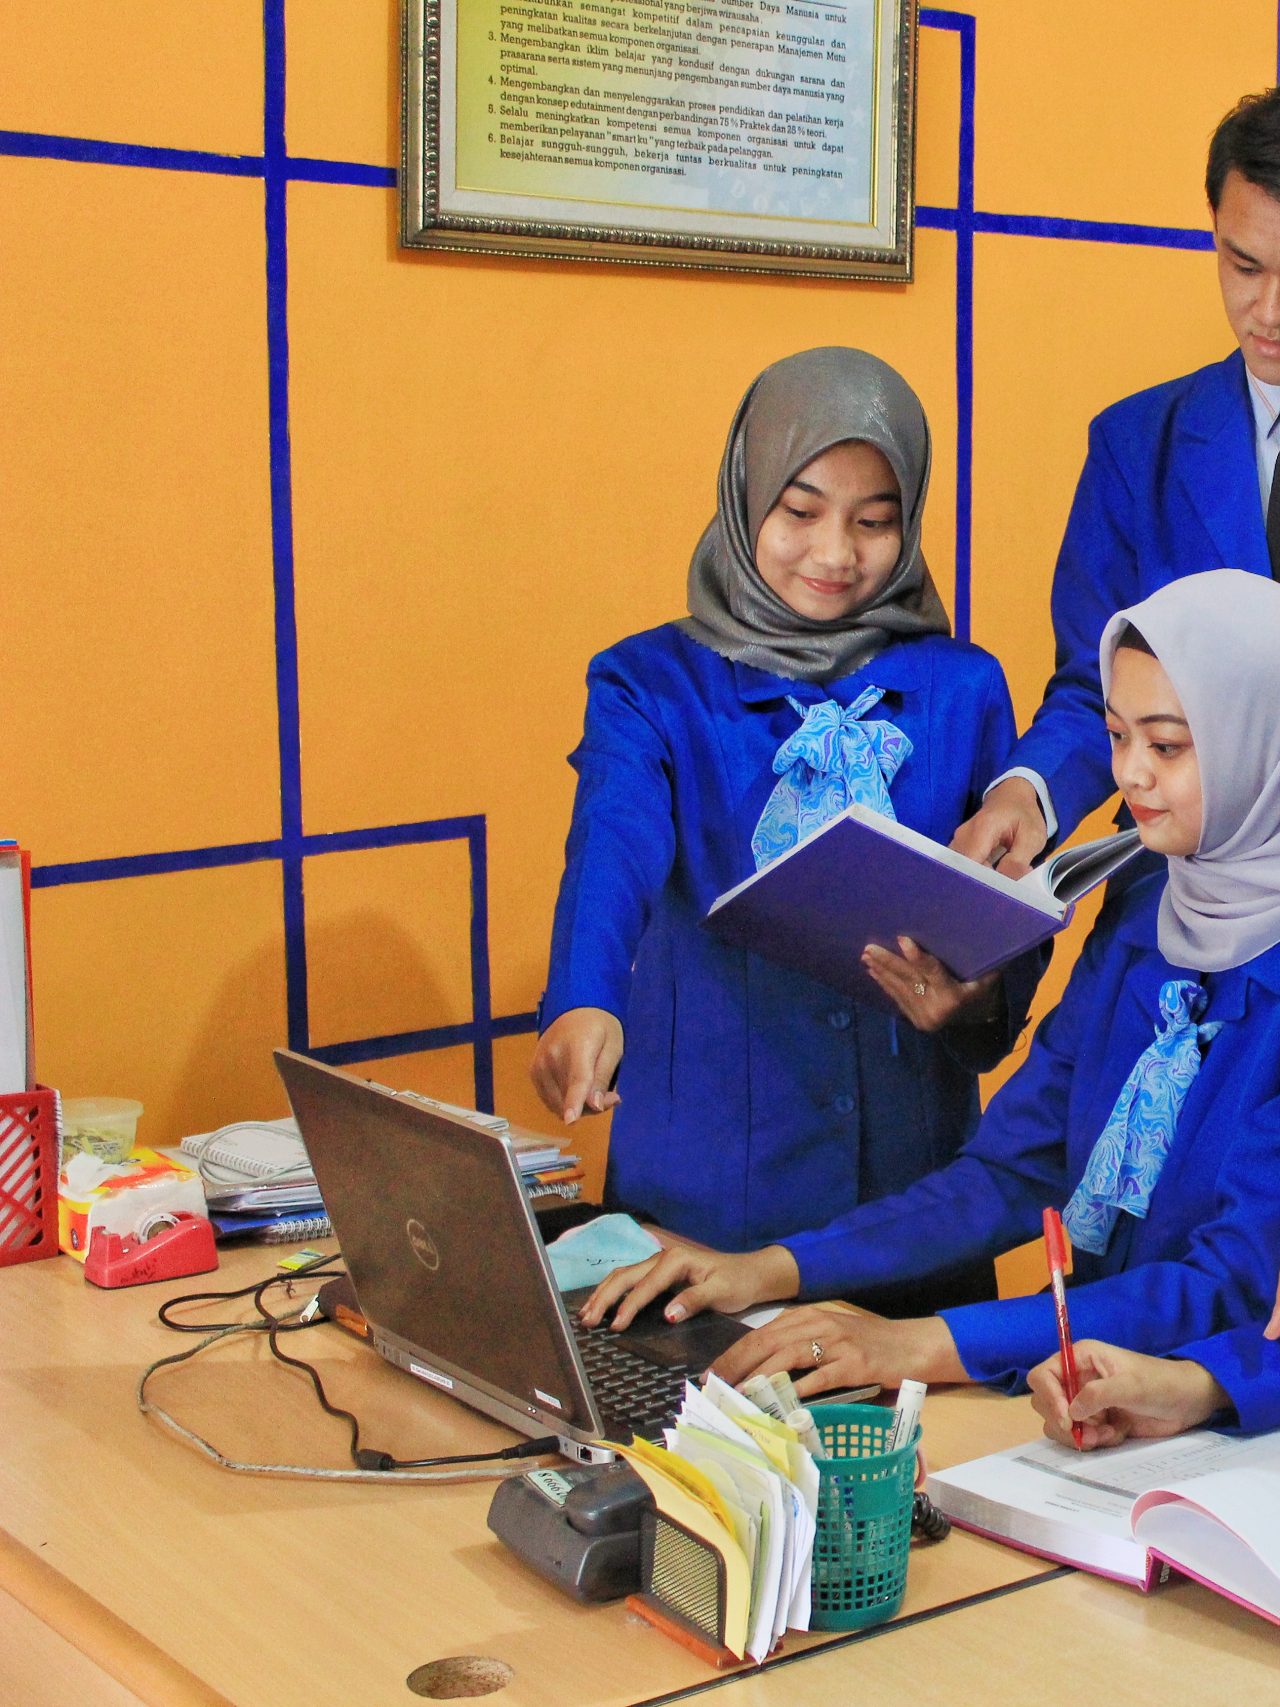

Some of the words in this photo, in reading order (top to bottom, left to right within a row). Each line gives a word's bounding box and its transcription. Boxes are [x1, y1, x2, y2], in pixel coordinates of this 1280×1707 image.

[500, 5, 558, 21] peningkatan
[562, 11, 597, 26] kualitas
[600, 19, 629, 31] secara
[633, 22, 692, 40] berkelanjutan
[695, 32, 727, 46] dengan
[730, 39, 774, 53] penerapan
[777, 44, 823, 59] Manajemen
[580, 2, 626, 17] semangat
[632, 8, 680, 24] kompetitif
[685, 16, 713, 29] dalam
[719, 23, 770, 38] pencapaian
[776, 30, 825, 46] keunggulan
[830, 39, 846, 49] dan
[664, 1, 685, 14] yang
[686, 2, 718, 17] berjiwa
[759, 0, 780, 14] Daya
[786, 4, 819, 19] Manusia
[824, 13, 847, 24] untuk
[500, 20, 524, 33] yang
[527, 23, 578, 38] melibatkan
[579, 31, 608, 42] semua
[609, 32, 655, 49] komponen
[488, 30, 497, 42] 3.
[500, 32, 581, 53] Mengembangkan
[586, 44, 609, 56] iklim
[615, 48, 646, 62] belajar
[651, 55, 673, 67] yang
[678, 56, 714, 71] kondusif
[719, 63, 750, 77] dengan
[755, 68, 795, 83] dukungan
[800, 75, 825, 86] sarana
[830, 78, 845, 89] dan
[500, 64, 538, 76] optimal.
[500, 49, 546, 62] prasarana
[547, 55, 570, 65] serta
[571, 58, 601, 69] sistem
[602, 62, 623, 75] yang
[625, 65, 673, 81] menunjang
[674, 72, 739, 88] pengembangan
[740, 81, 771, 92] sumber
[772, 83, 792, 96] daya
[793, 88, 825, 99] manusia
[825, 92, 845, 103] yang
[488, 75, 496, 85] 4.
[500, 75, 580, 95] Mengembangkan
[583, 86, 600, 98] dan
[603, 90, 685, 108] menyelenggarakan
[688, 101, 716, 111] proses
[718, 105, 765, 118] pendidikan
[767, 109, 783, 120] dan
[785, 112, 822, 124] pelatihan
[824, 116, 844, 128] kerja
[500, 90, 535, 105] dengan
[536, 94, 569, 110] konsep
[570, 99, 625, 114] edutainment
[625, 106, 659, 119] dengan
[659, 111, 719, 126] perbandingan
[730, 117, 739, 128] %
[739, 119, 770, 131] Praktek
[771, 123, 786, 133] dan
[797, 125, 805, 136] %
[499, 104, 529, 117] Selalu
[535, 111, 600, 125] meningkatkan
[606, 116, 657, 132] kompetensi
[663, 126, 691, 136] semua
[697, 127, 741, 141] komponen
[747, 135, 788, 147] organisasi
[793, 140, 816, 150] untuk
[821, 142, 844, 153] dapat
[500, 121, 559, 135] memberikan
[559, 127, 605, 140] pelayanan
[676, 140, 706, 151] terbaik
[707, 143, 728, 154] pada
[487, 132, 496, 143] 6.
[500, 133, 534, 148] Belajar
[541, 140, 628, 157] sungguh-sungguh,
[634, 147, 669, 162] bekerja
[676, 153, 702, 164] tuntas
[708, 155, 757, 170] berkualitas
[763, 163, 787, 173] untuk
[792, 167, 843, 179] peningkatan
[500, 148, 564, 164] kesejahteraan
[564, 157, 593, 166] semua
[594, 157, 640, 172] komponen
